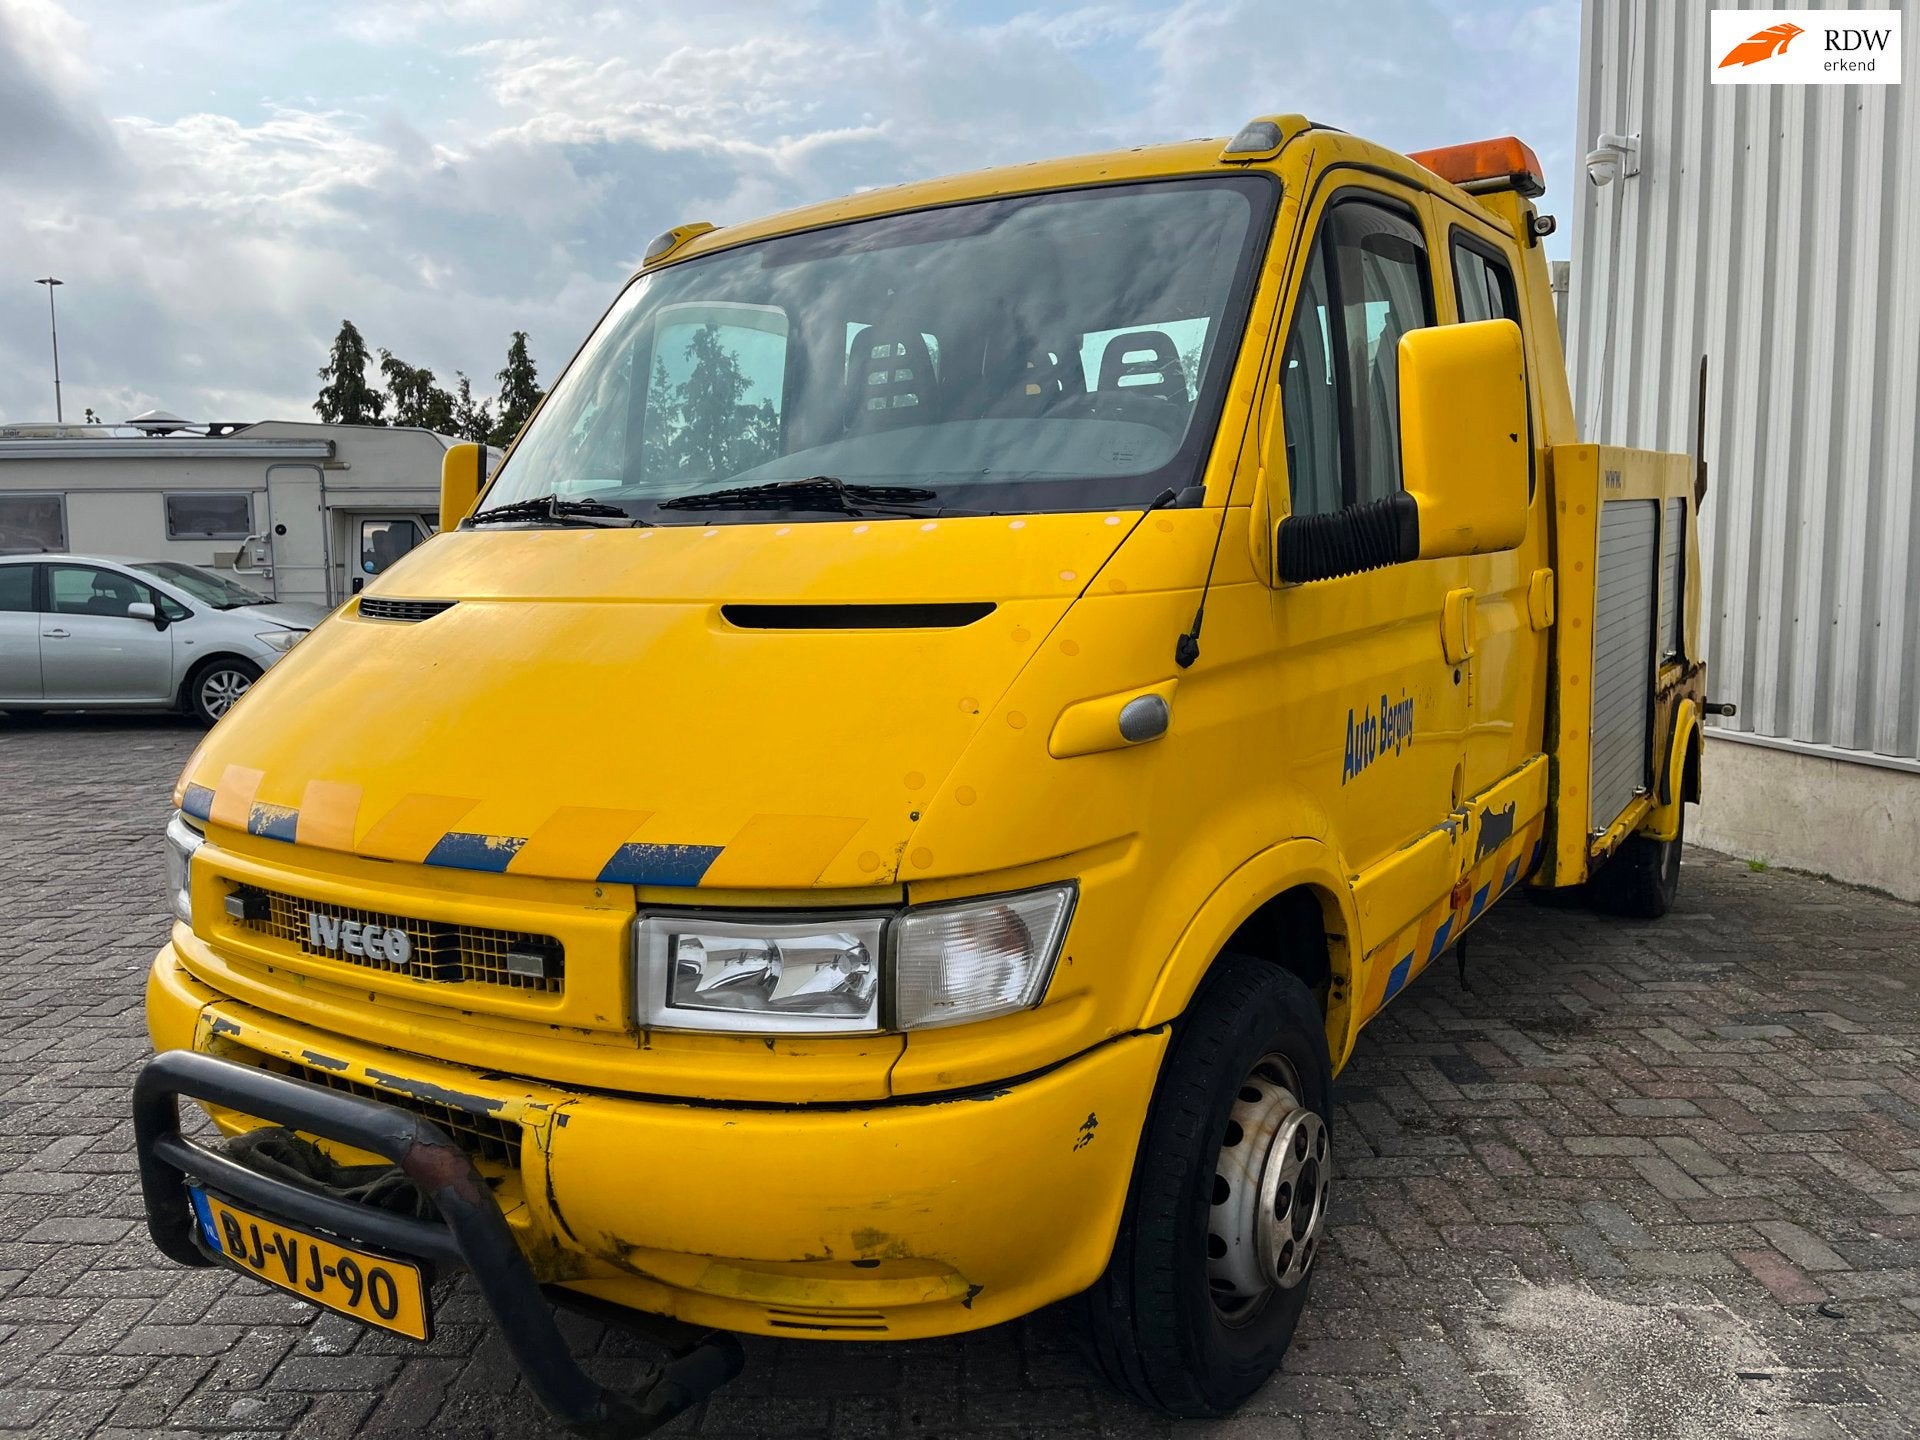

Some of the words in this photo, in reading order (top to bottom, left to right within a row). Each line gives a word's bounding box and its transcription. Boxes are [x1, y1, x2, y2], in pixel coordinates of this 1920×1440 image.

[1342, 702, 1376, 787] Auto
[1380, 687, 1414, 757] Berging
[309, 913, 411, 964] IVECO
[204, 1222, 218, 1240] NL
[220, 1209, 399, 1320] BJ-VJ-90
